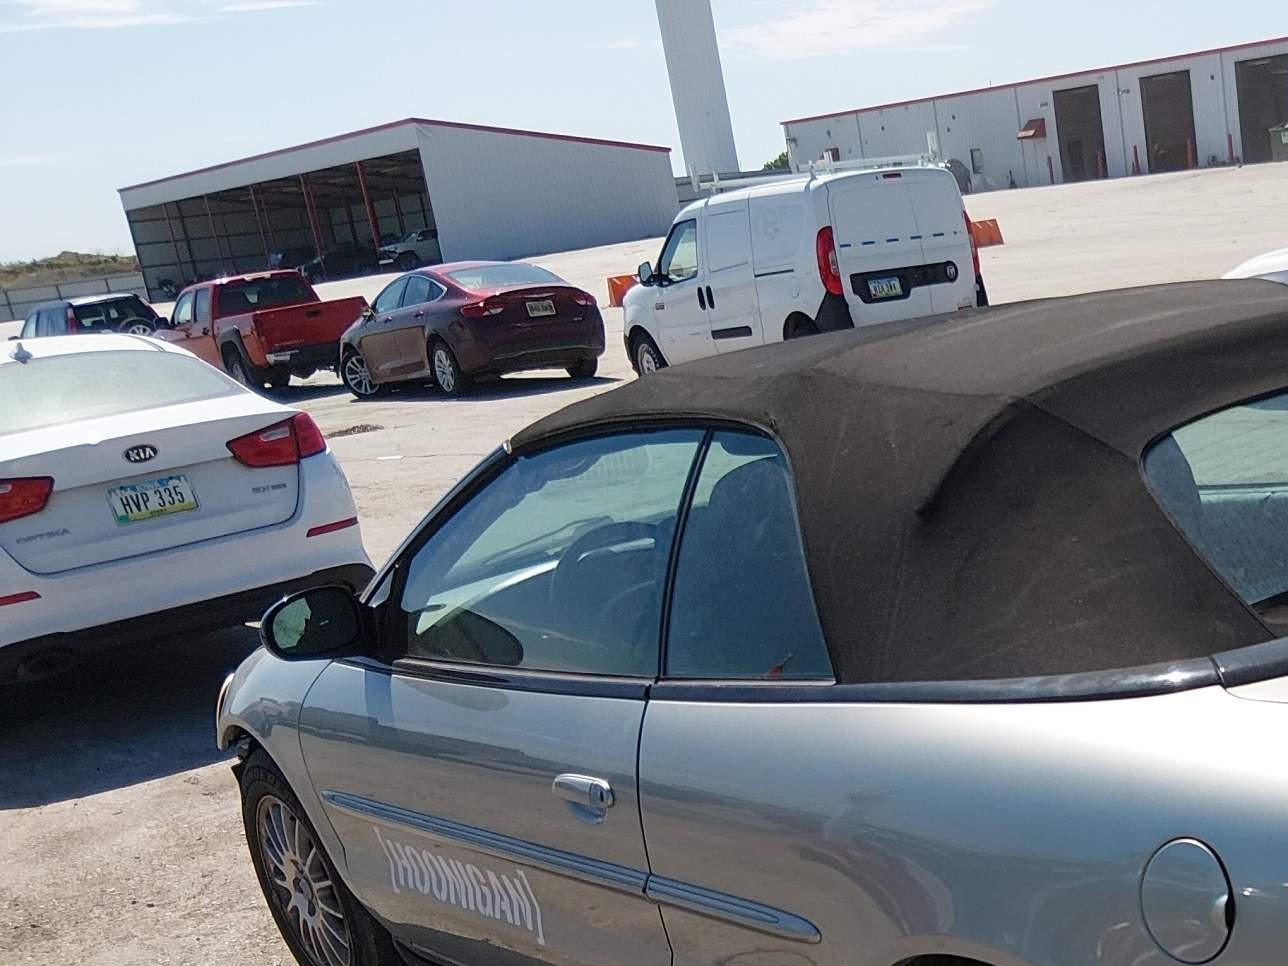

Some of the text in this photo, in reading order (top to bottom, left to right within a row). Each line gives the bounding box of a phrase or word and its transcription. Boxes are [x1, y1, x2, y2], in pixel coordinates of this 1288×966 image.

[127, 447, 156, 462] KIA
[119, 492, 150, 514] HVP
[154, 485, 186, 508] 335
